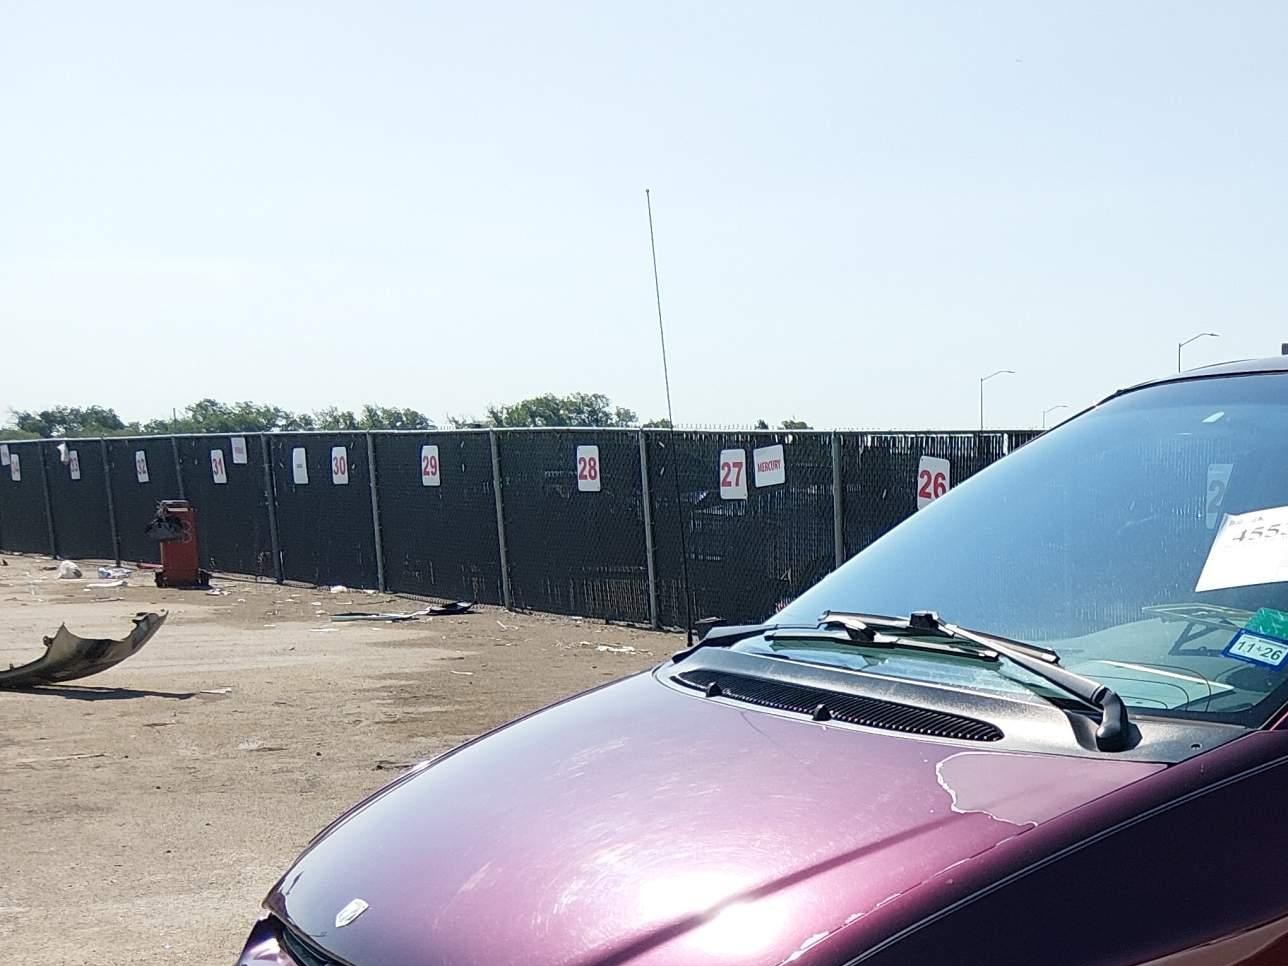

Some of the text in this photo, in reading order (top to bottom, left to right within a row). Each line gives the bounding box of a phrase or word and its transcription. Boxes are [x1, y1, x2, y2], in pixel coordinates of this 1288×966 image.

[212, 457, 225, 475] 31
[332, 456, 346, 475] 30
[422, 455, 438, 476] 29
[578, 456, 598, 480] 28
[721, 461, 744, 487] 27
[918, 469, 947, 499] 26
